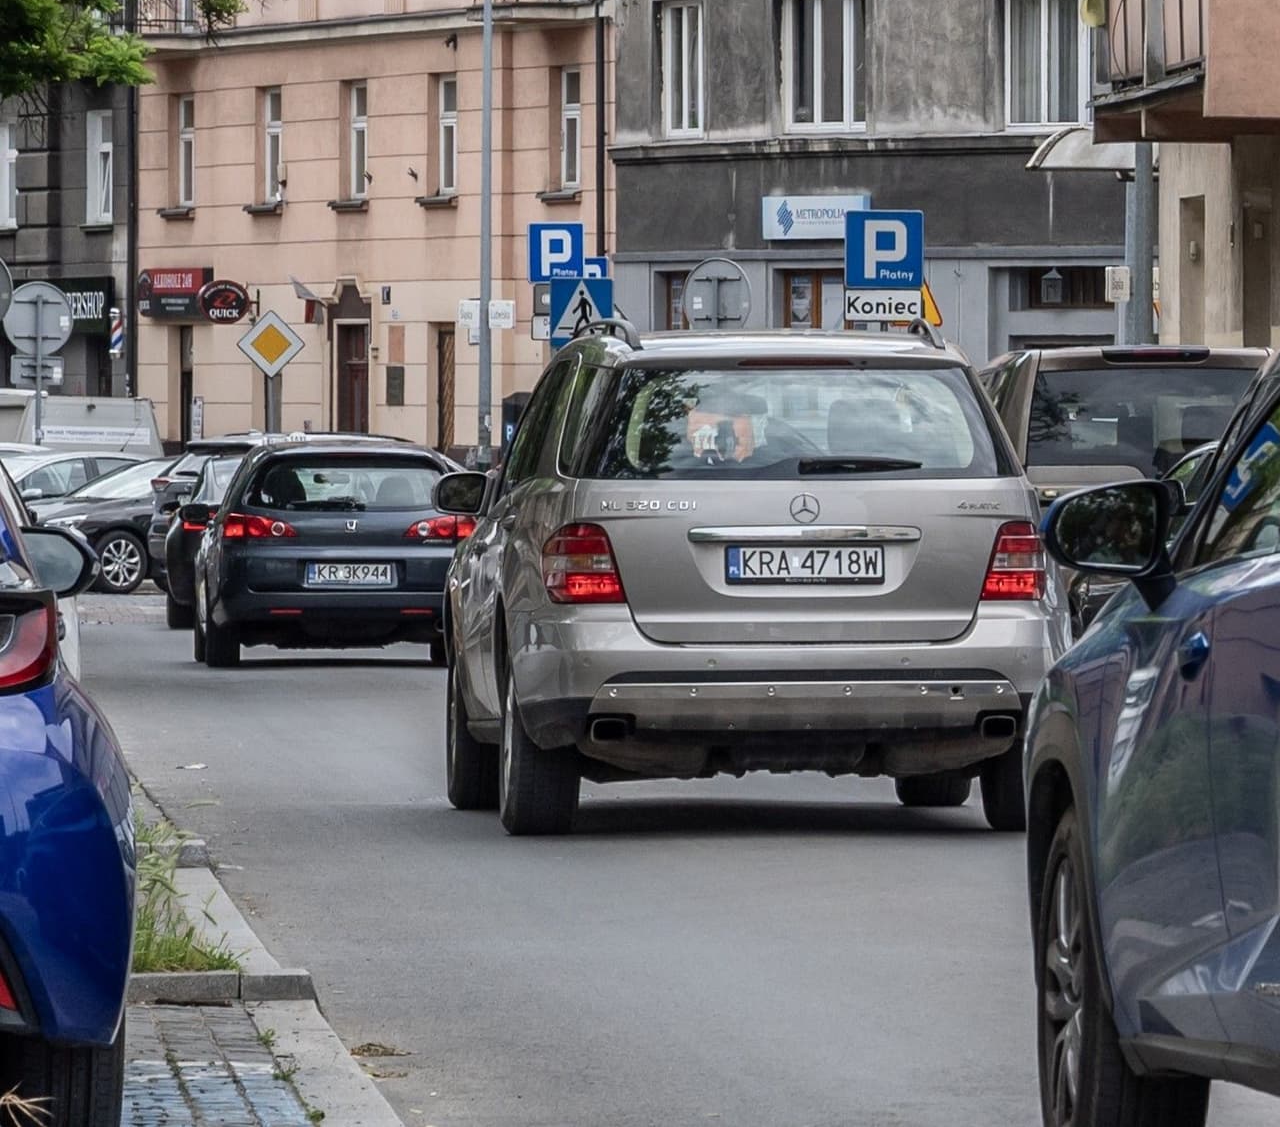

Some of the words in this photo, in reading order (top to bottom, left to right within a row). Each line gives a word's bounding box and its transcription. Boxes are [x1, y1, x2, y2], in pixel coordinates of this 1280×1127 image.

[541, 229, 572, 277] P
[864, 219, 908, 279] P
[879, 269, 914, 282] Płatny
[209, 308, 240, 319] QUICK
[847, 296, 918, 315] Koniec
[317, 565, 338, 580] KR
[343, 565, 388, 580] 3K944
[742, 550, 791, 576] KRA
[801, 550, 878, 576] 4718W
